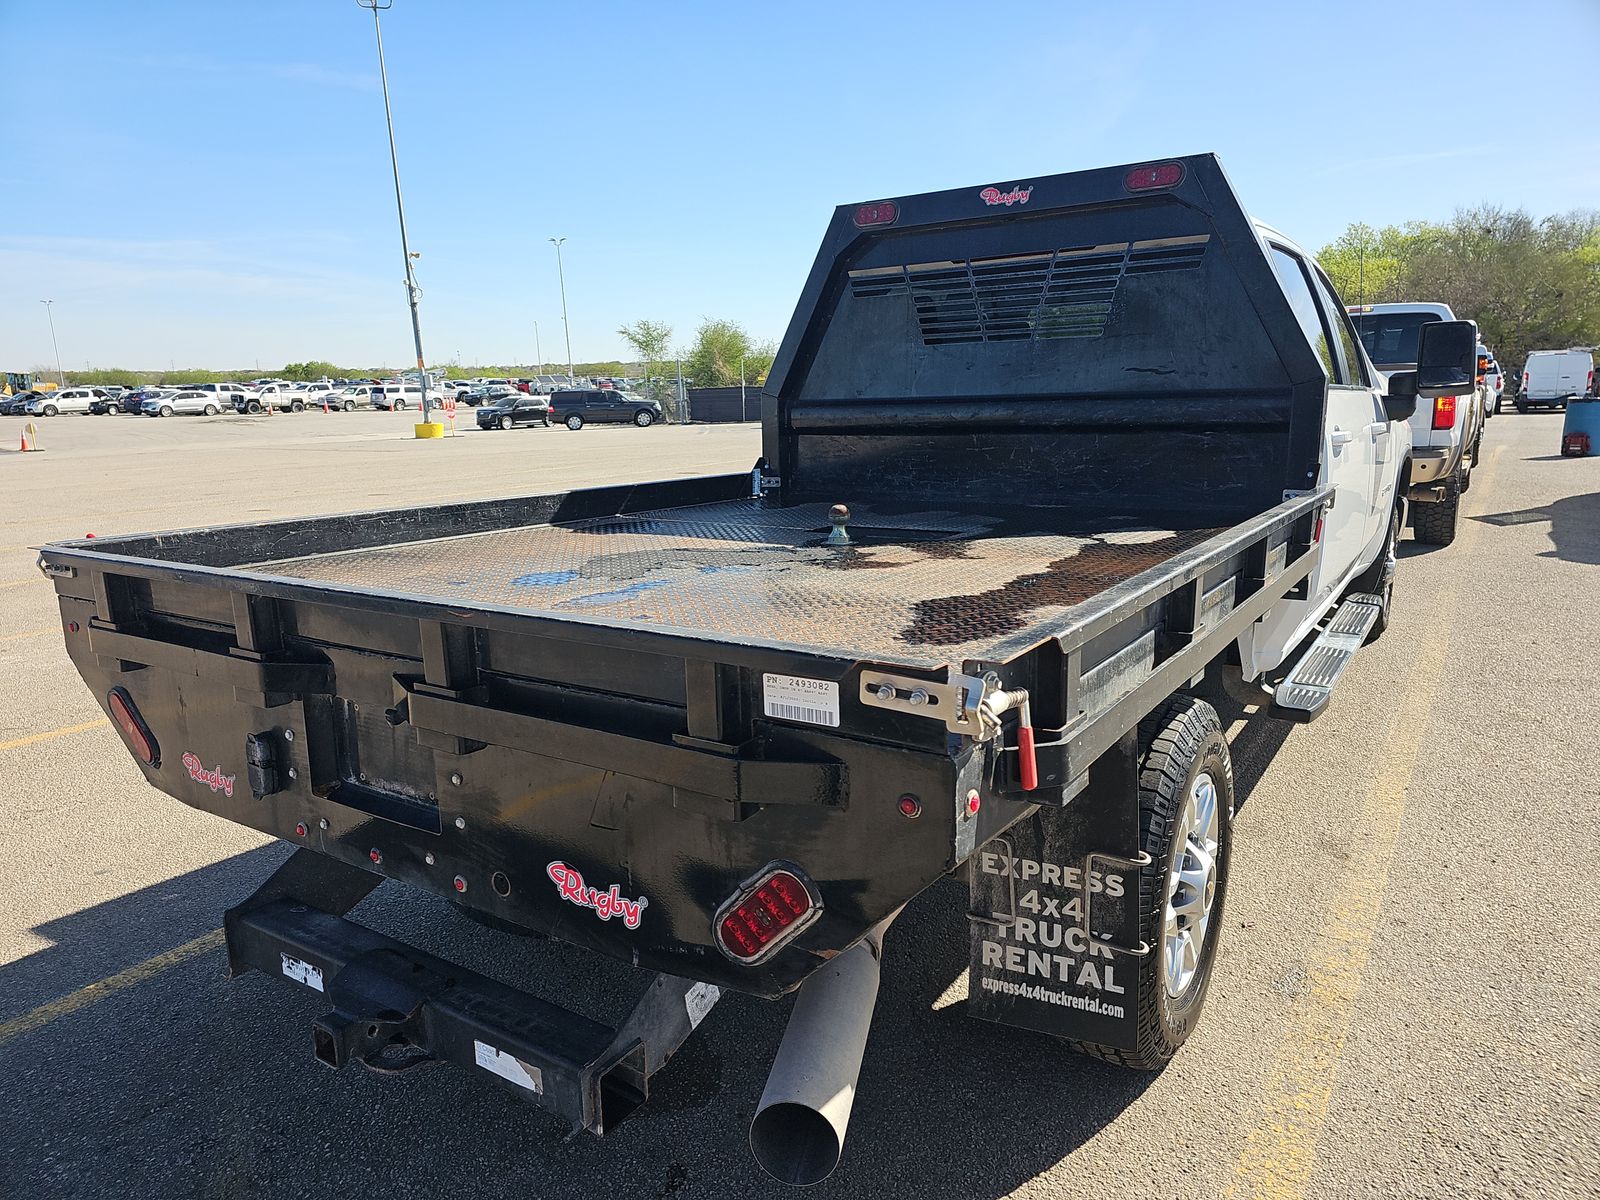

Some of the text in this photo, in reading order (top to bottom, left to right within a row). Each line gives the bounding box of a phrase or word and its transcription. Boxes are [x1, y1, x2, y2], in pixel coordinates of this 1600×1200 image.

[980, 185, 1032, 206] Rugby
[766, 676, 782, 685] PN:
[789, 678, 830, 691] 2493082
[181, 751, 235, 798] Rugby
[546, 860, 644, 930] Rugby
[981, 851, 1125, 897] EXPRESS
[1019, 889, 1084, 923] 4x4
[982, 940, 1125, 995] RENTAL
[981, 977, 1125, 1019] express4x4truckrental.com
